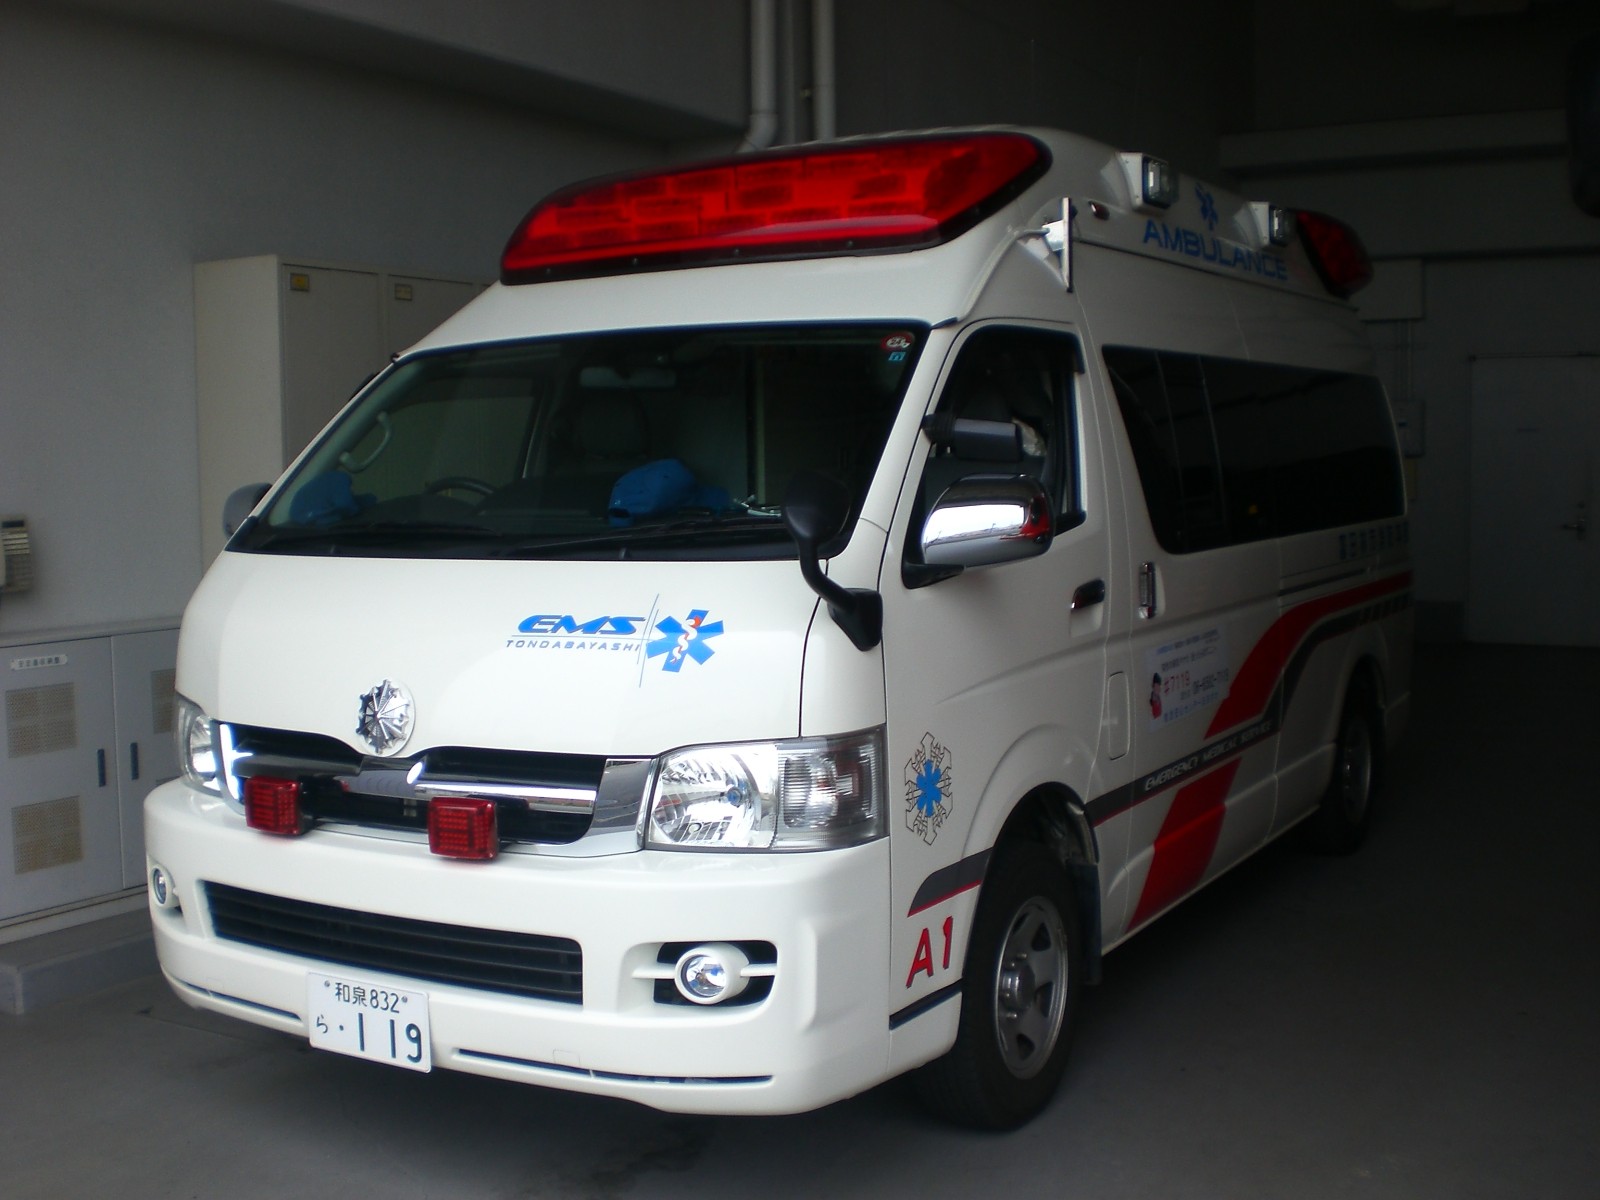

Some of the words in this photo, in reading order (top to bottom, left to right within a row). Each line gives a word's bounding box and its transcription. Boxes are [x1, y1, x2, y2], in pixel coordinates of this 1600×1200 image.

[1143, 219, 1288, 280] AMBULANCE
[518, 614, 646, 635] EMS
[506, 639, 641, 652] TONDABAYASHI
[1144, 756, 1199, 791] EMERGENCY
[905, 915, 954, 989] A1
